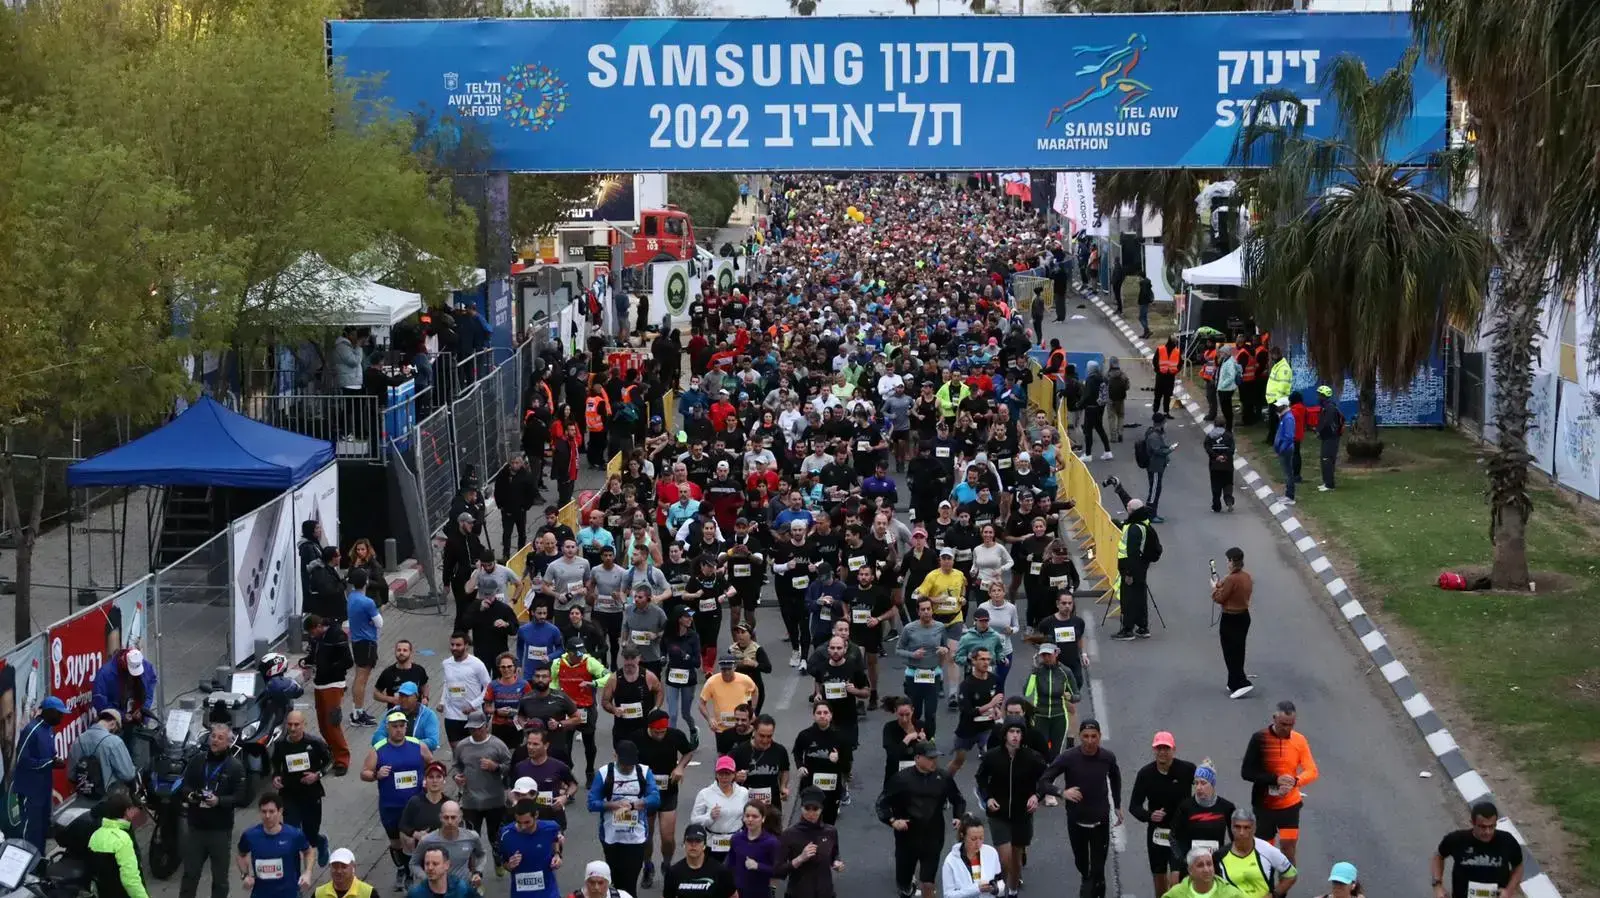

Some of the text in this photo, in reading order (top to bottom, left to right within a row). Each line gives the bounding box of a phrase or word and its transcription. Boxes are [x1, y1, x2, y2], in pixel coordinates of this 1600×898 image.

[588, 42, 1015, 92] מרתון SAMSUNG
[1218, 50, 1320, 93] זינוק
[465, 83, 485, 94] TEL
[448, 94, 502, 105] אביב AVIV
[1122, 106, 1180, 119] TEL AVIV
[1215, 99, 1321, 127] START
[649, 103, 749, 148] 2022
[1065, 122, 1151, 137] SAMSUNG
[1037, 138, 1109, 150] MARATHON
